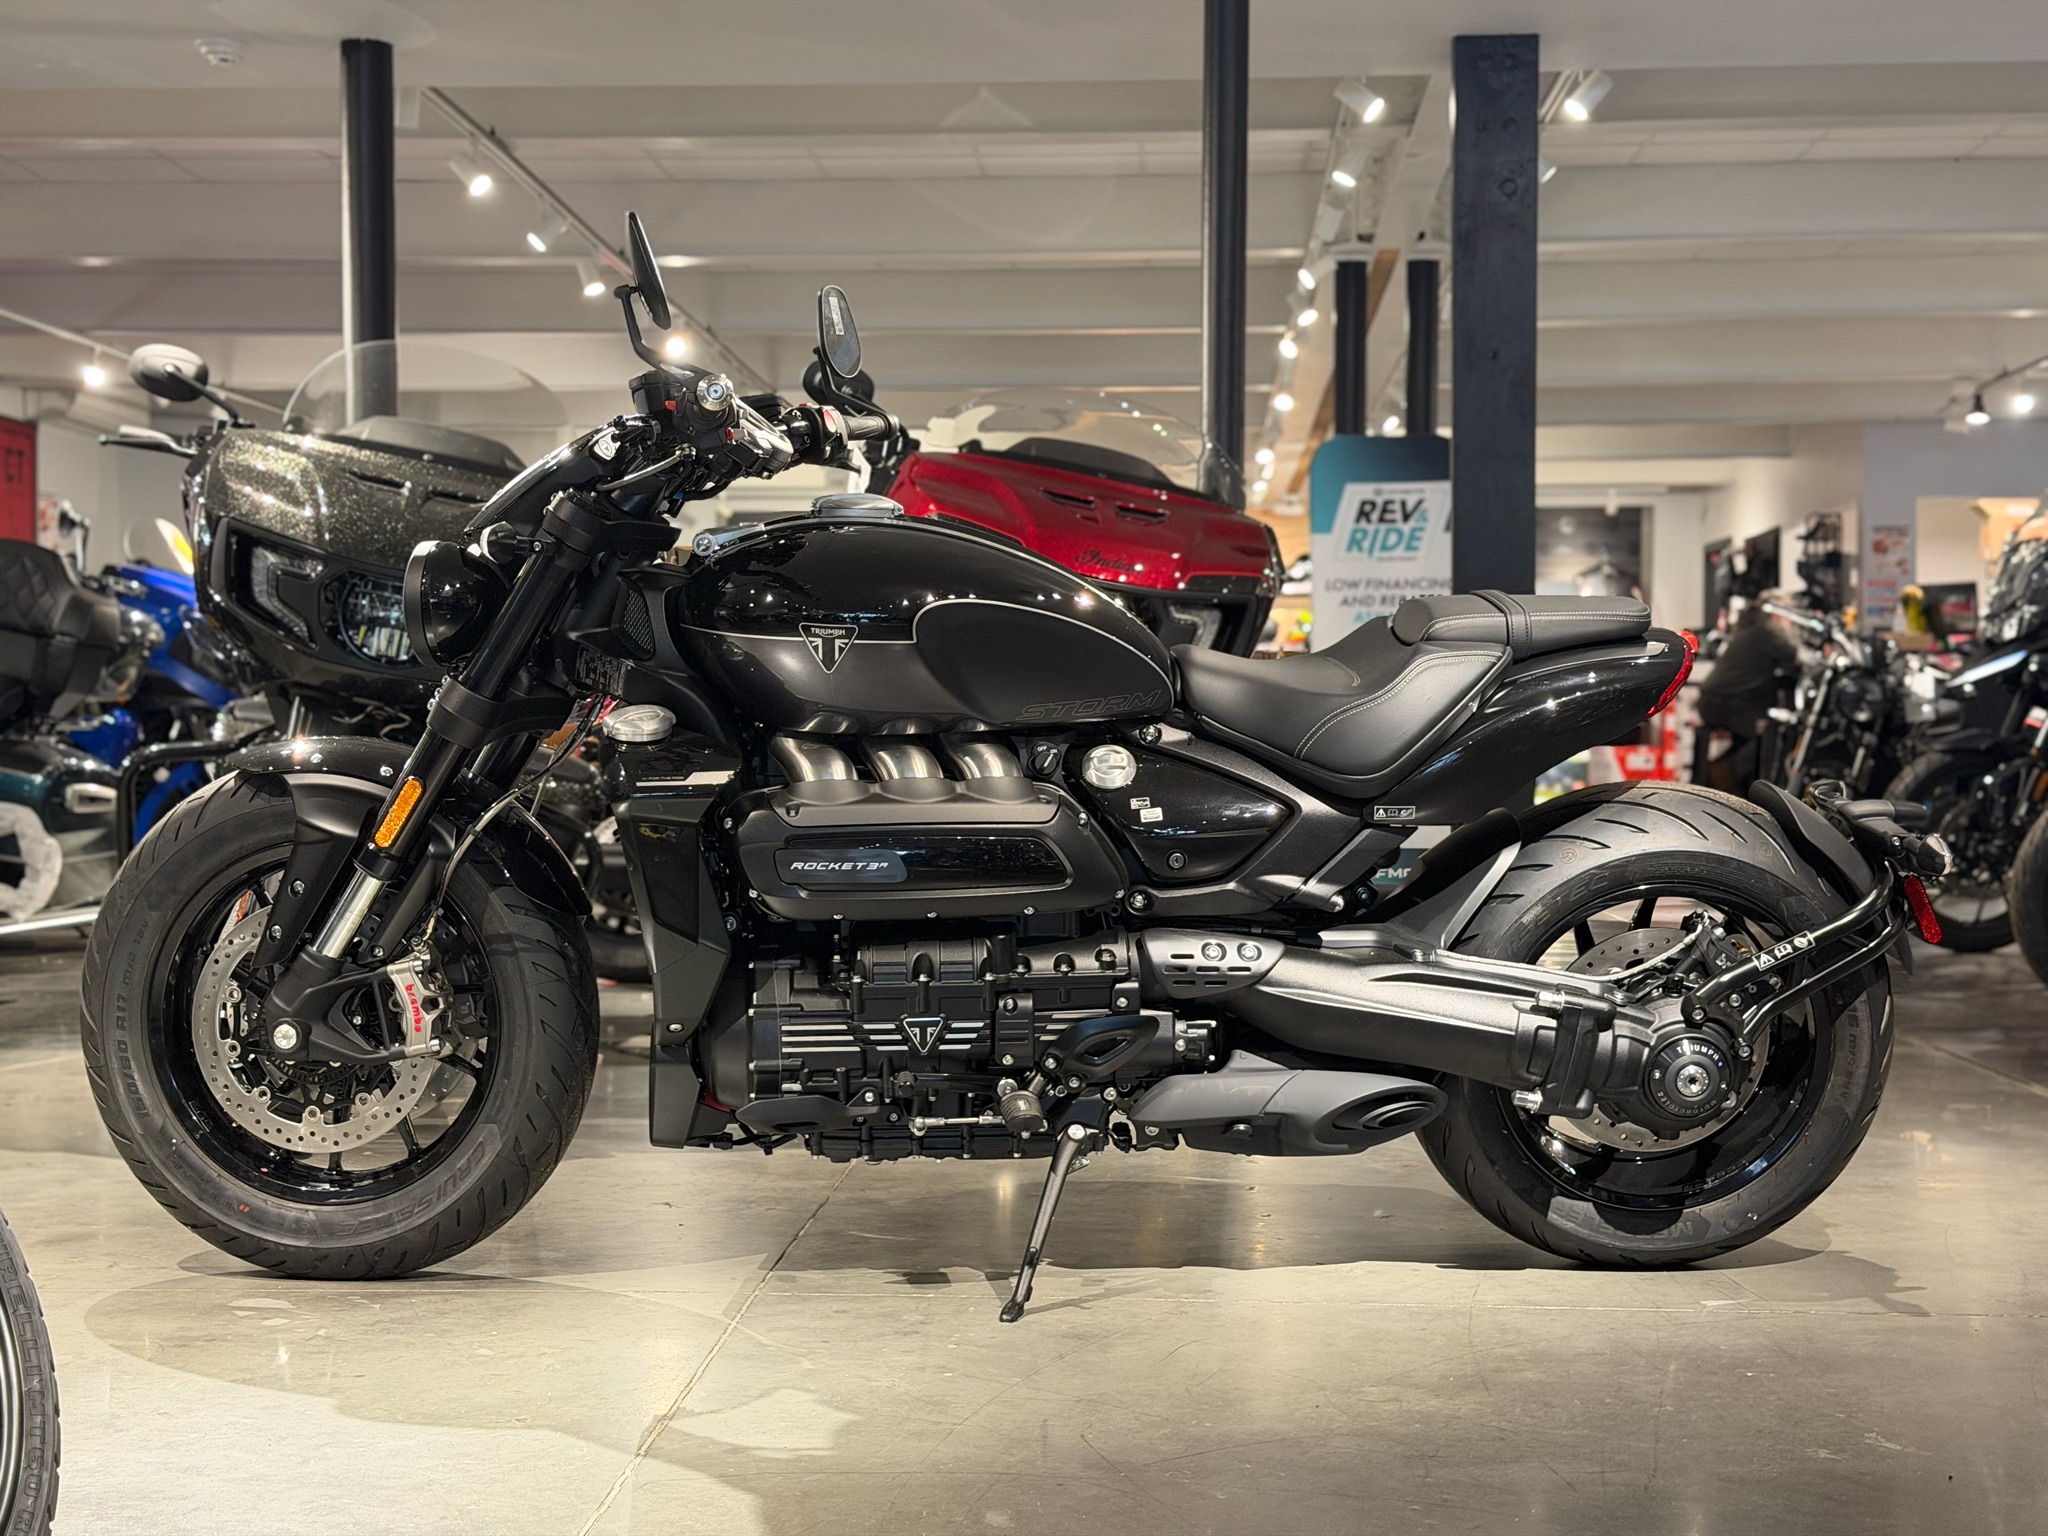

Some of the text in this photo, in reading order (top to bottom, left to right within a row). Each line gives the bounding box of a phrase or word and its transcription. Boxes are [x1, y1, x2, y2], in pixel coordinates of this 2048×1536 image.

[1345, 527, 1424, 557] RIDE
[1325, 578, 1359, 592] LOW
[1340, 594, 1376, 607] AND
[811, 627, 846, 637] TRIUMPH
[1015, 689, 1162, 721] STORM
[405, 983, 424, 1034] brembo
[1676, 1044, 1720, 1061] TRIUMPH
[1657, 1091, 1718, 1114] MOTORCYCLES
[0, 1230, 43, 1378] IRELLI
[24, 1390, 47, 1502] MT60
